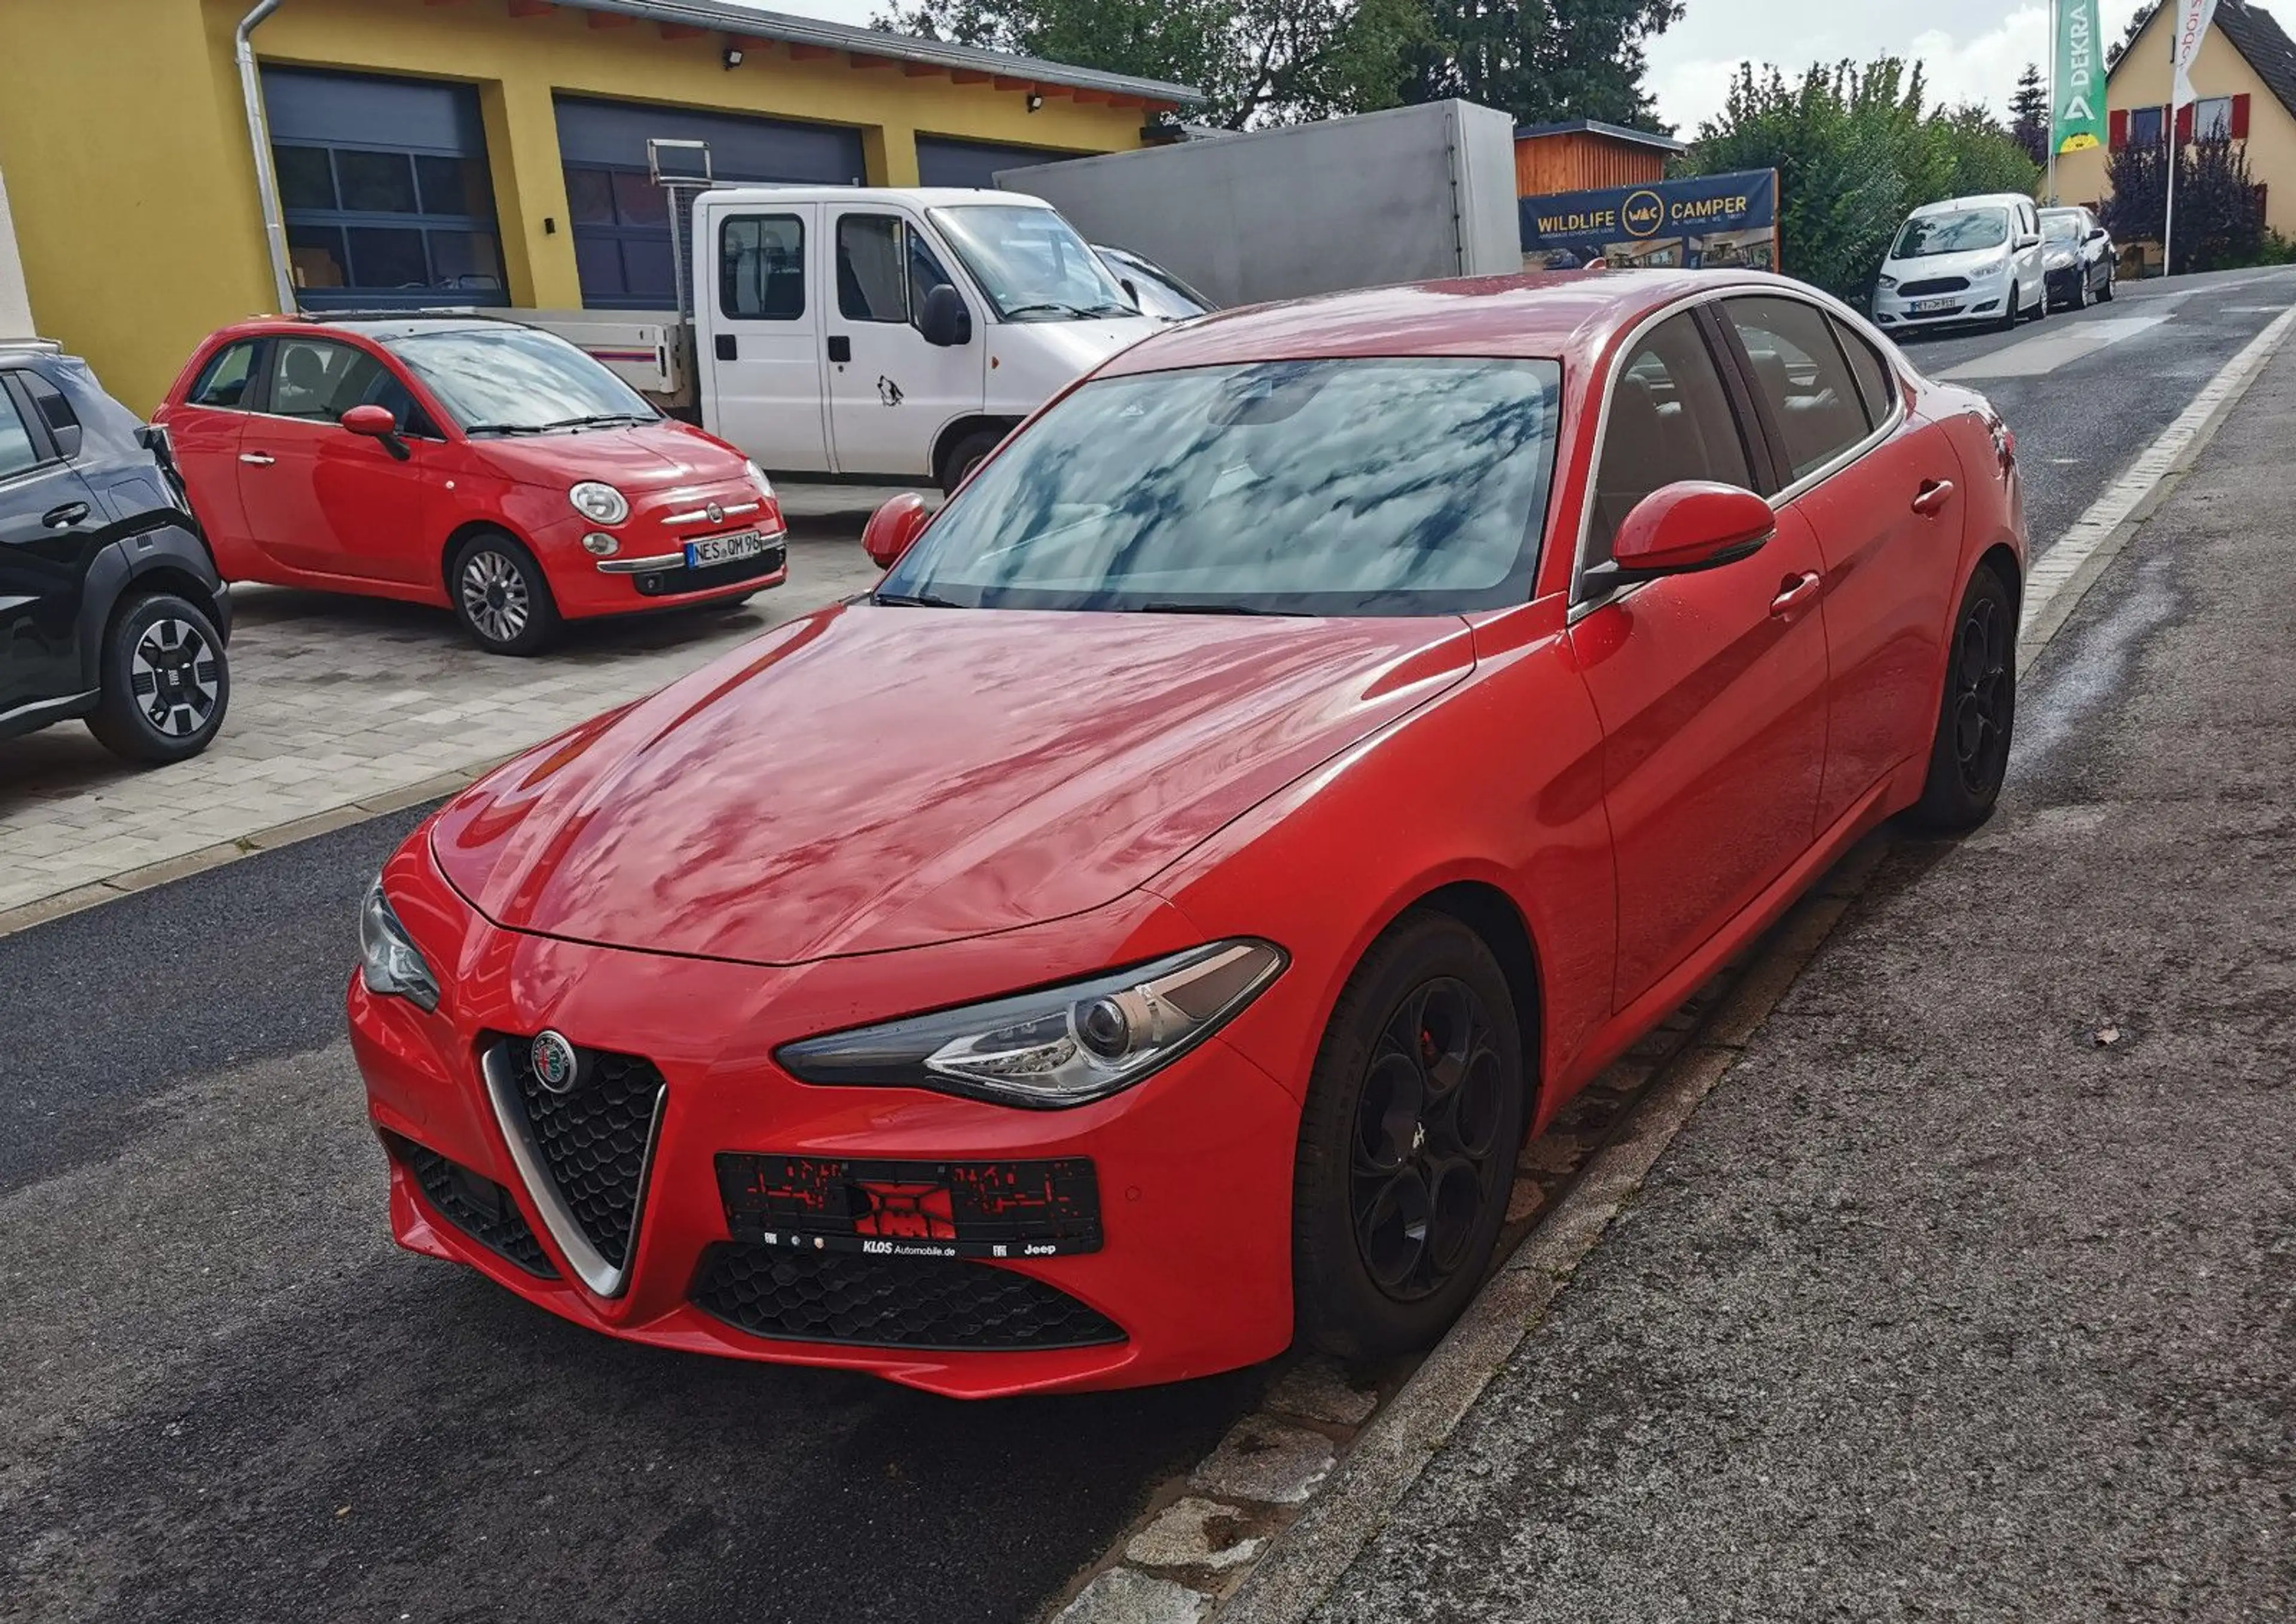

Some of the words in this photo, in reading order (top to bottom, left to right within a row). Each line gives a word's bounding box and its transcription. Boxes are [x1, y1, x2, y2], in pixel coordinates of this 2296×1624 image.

[2070, 1, 2089, 87] DEKRA
[1538, 210, 1614, 233] WILDLIFE
[1671, 196, 1747, 219] CAMPER
[695, 542, 720, 561] NES
[745, 533, 759, 551] 96
[863, 1241, 893, 1253] KLOS
[894, 1246, 955, 1256] Automobile.de
[1024, 1244, 1056, 1254] Jeep
